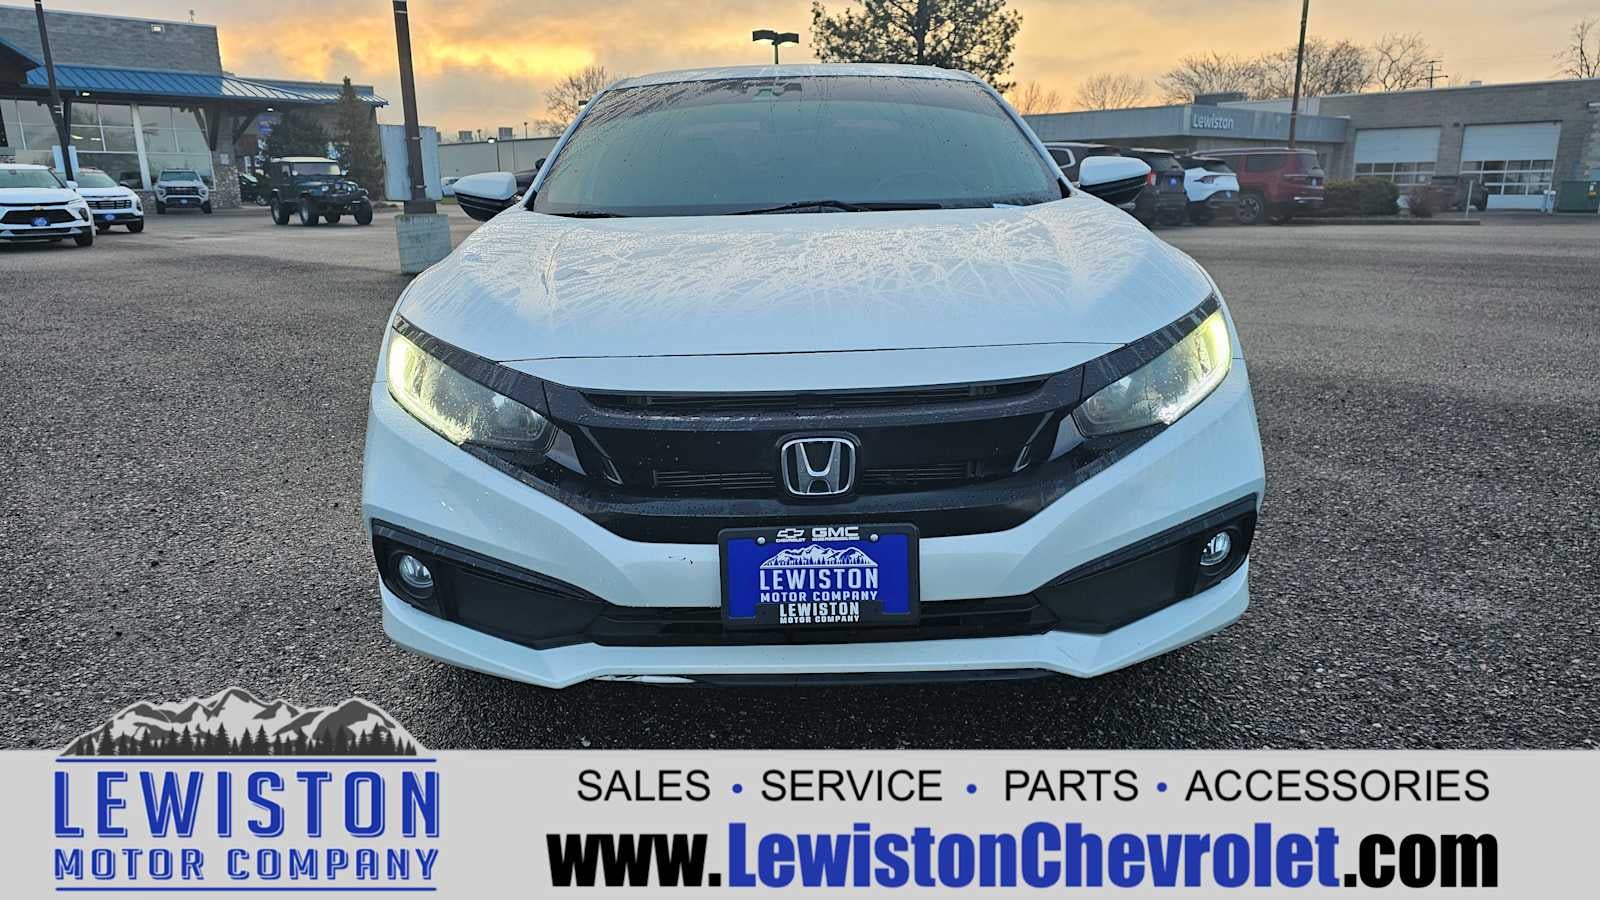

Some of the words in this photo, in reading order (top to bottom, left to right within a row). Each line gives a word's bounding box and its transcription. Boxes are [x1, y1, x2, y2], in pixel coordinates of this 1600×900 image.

[1192, 112, 1234, 129] Lewiston
[811, 526, 859, 537] GMC
[759, 568, 878, 591] LEWISTON
[760, 592, 807, 603] MOTOR
[812, 591, 878, 602] COMPANY
[779, 602, 860, 617] LEWISTON
[780, 616, 812, 624] MOTOR
[814, 615, 860, 623] COMPANY
